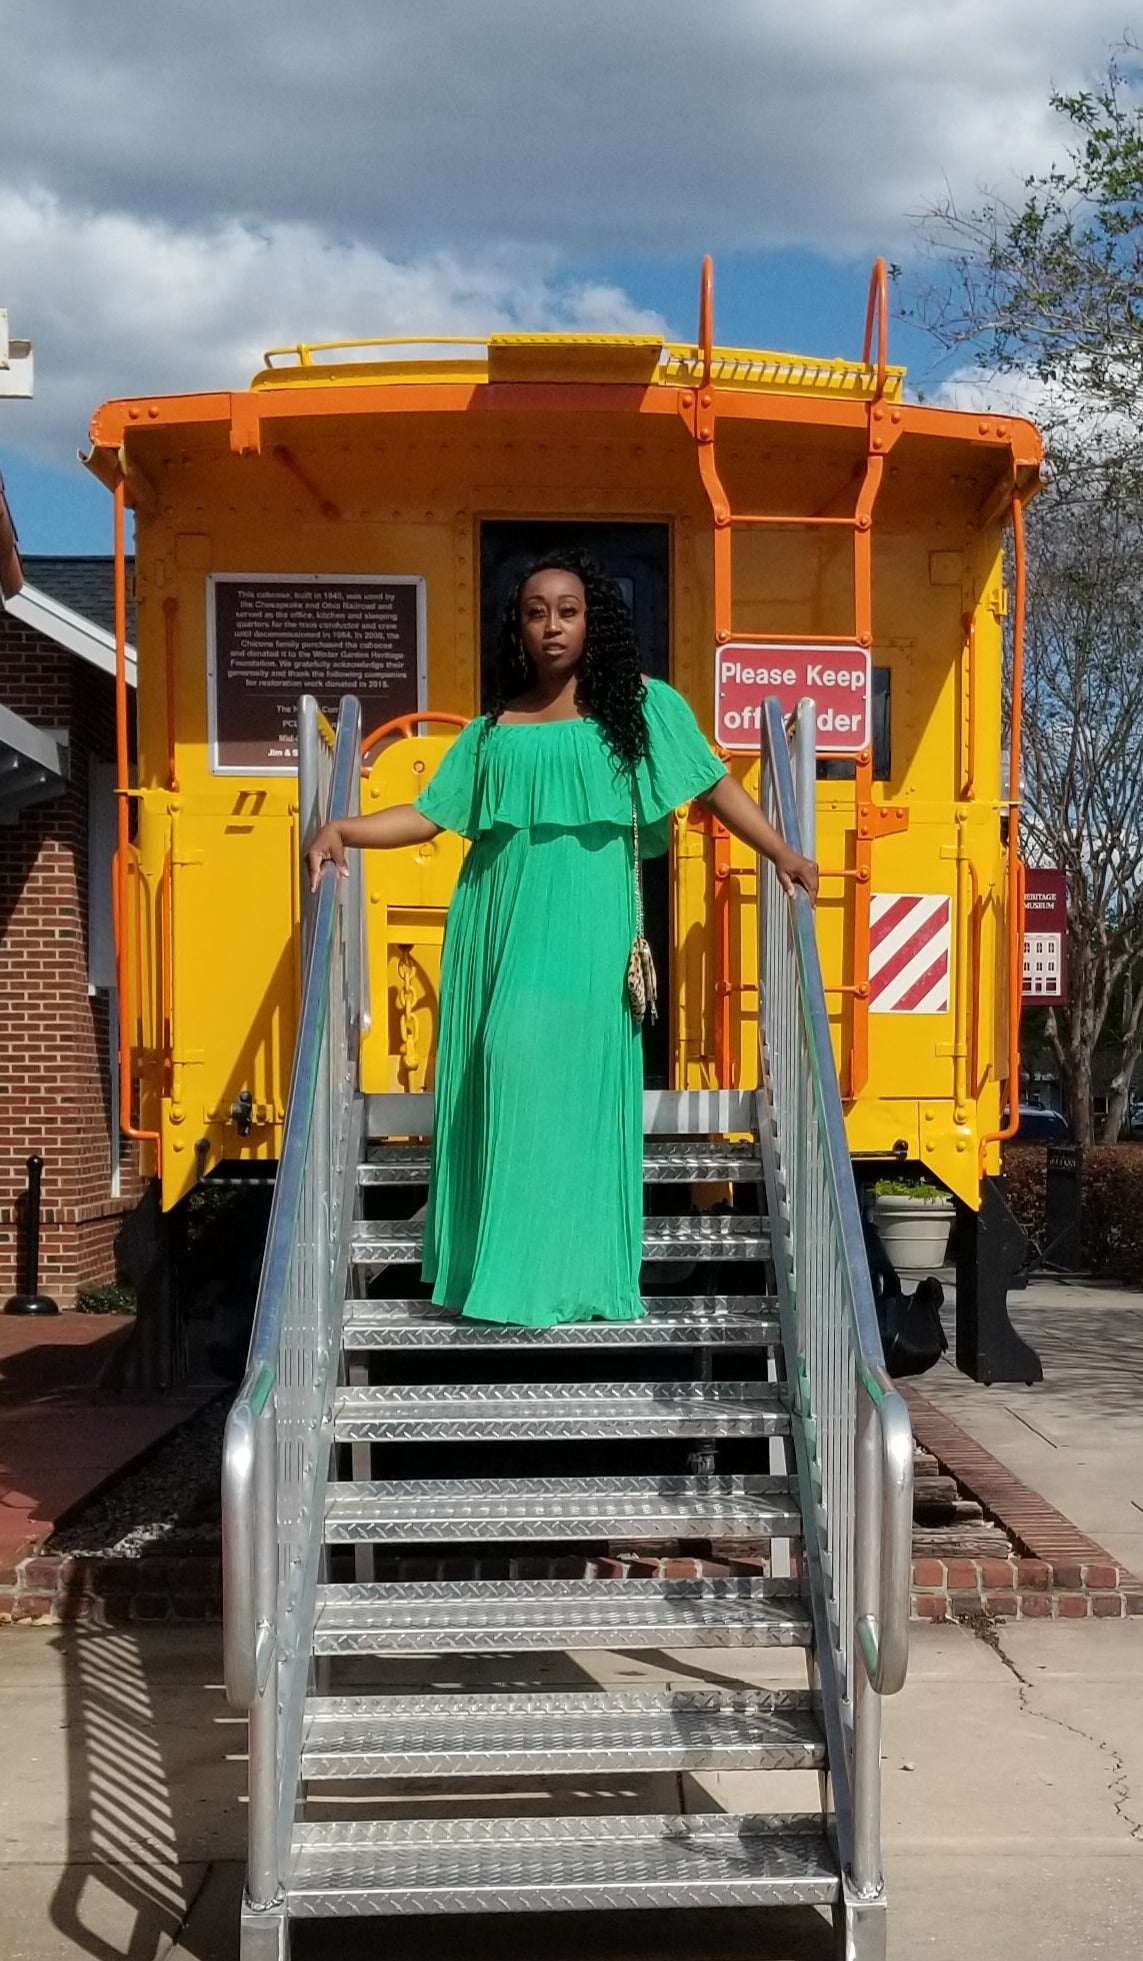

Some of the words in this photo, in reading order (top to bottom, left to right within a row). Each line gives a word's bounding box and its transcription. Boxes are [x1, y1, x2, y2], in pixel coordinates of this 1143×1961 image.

[385, 593, 395, 601] by
[276, 641, 299, 650] family
[722, 662, 796, 684] Please
[807, 664, 864, 691] Keep
[724, 707, 761, 728] off
